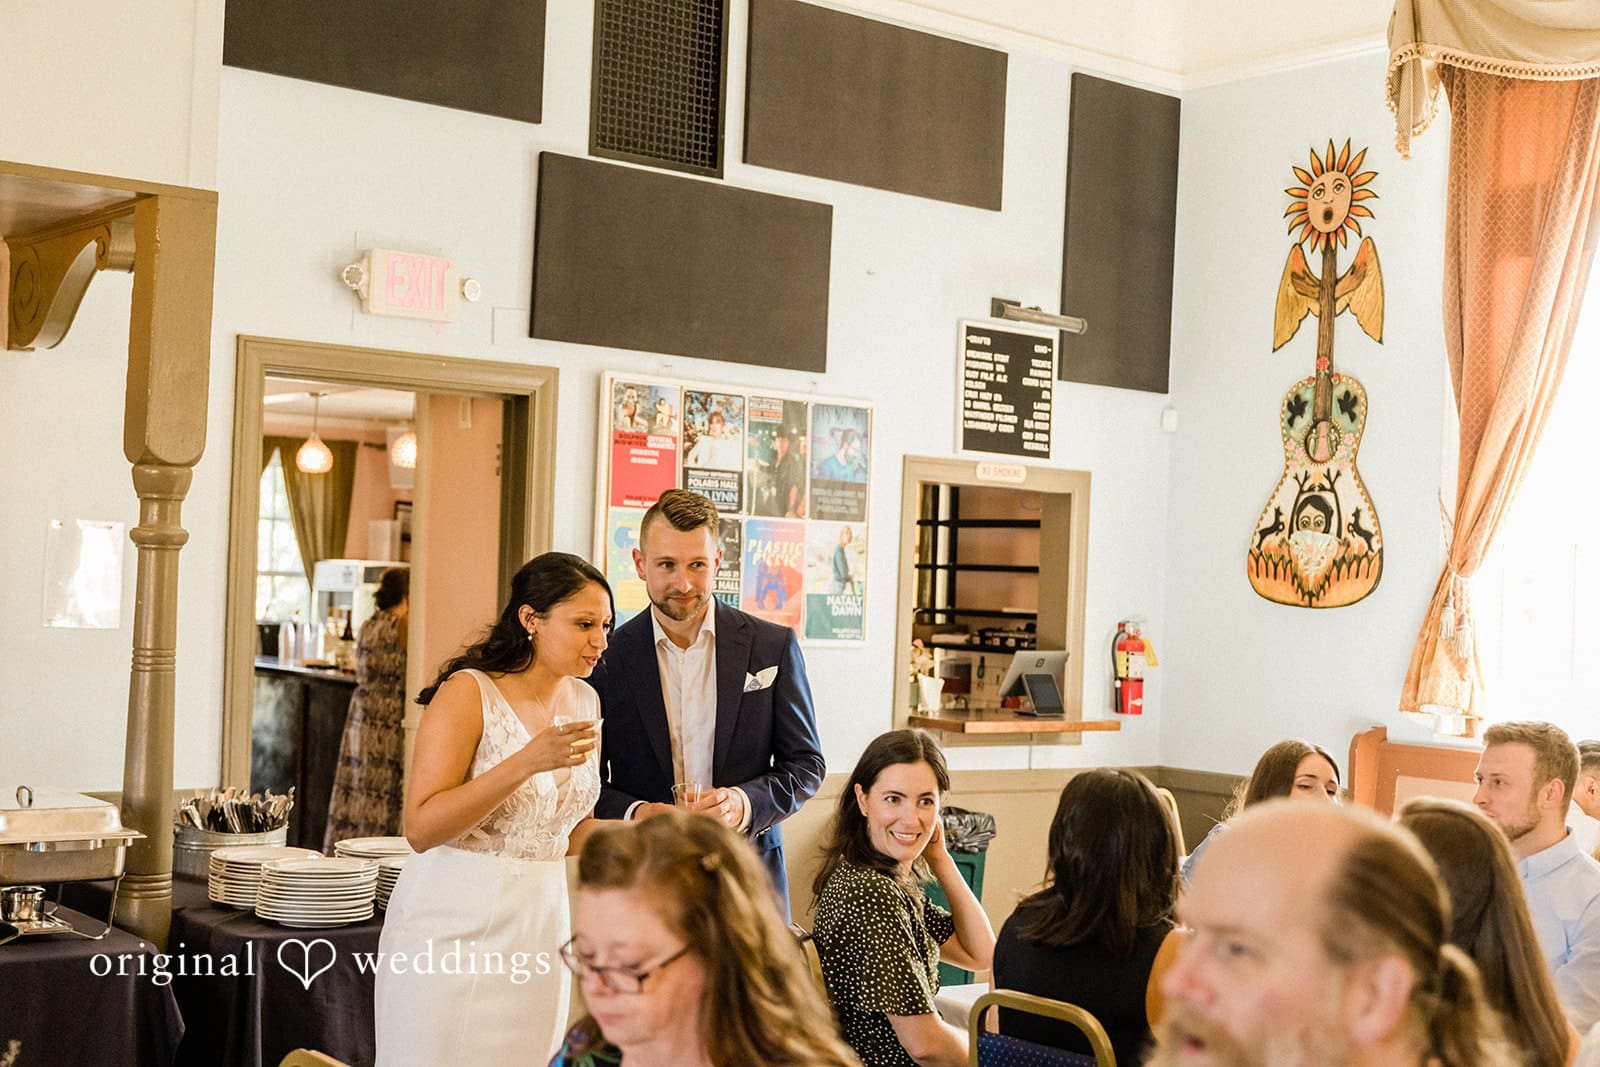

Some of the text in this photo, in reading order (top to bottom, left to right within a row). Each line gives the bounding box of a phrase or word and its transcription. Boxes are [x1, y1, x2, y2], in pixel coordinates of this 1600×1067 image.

[385, 252, 449, 312] EXIT
[688, 478, 738, 490] POLARIS HALL
[711, 490, 738, 503] LYNN
[748, 538, 803, 554] PLASTIC
[752, 551, 798, 568] PICNIC
[826, 595, 863, 606] NATALY
[832, 605, 861, 616] DAWN
